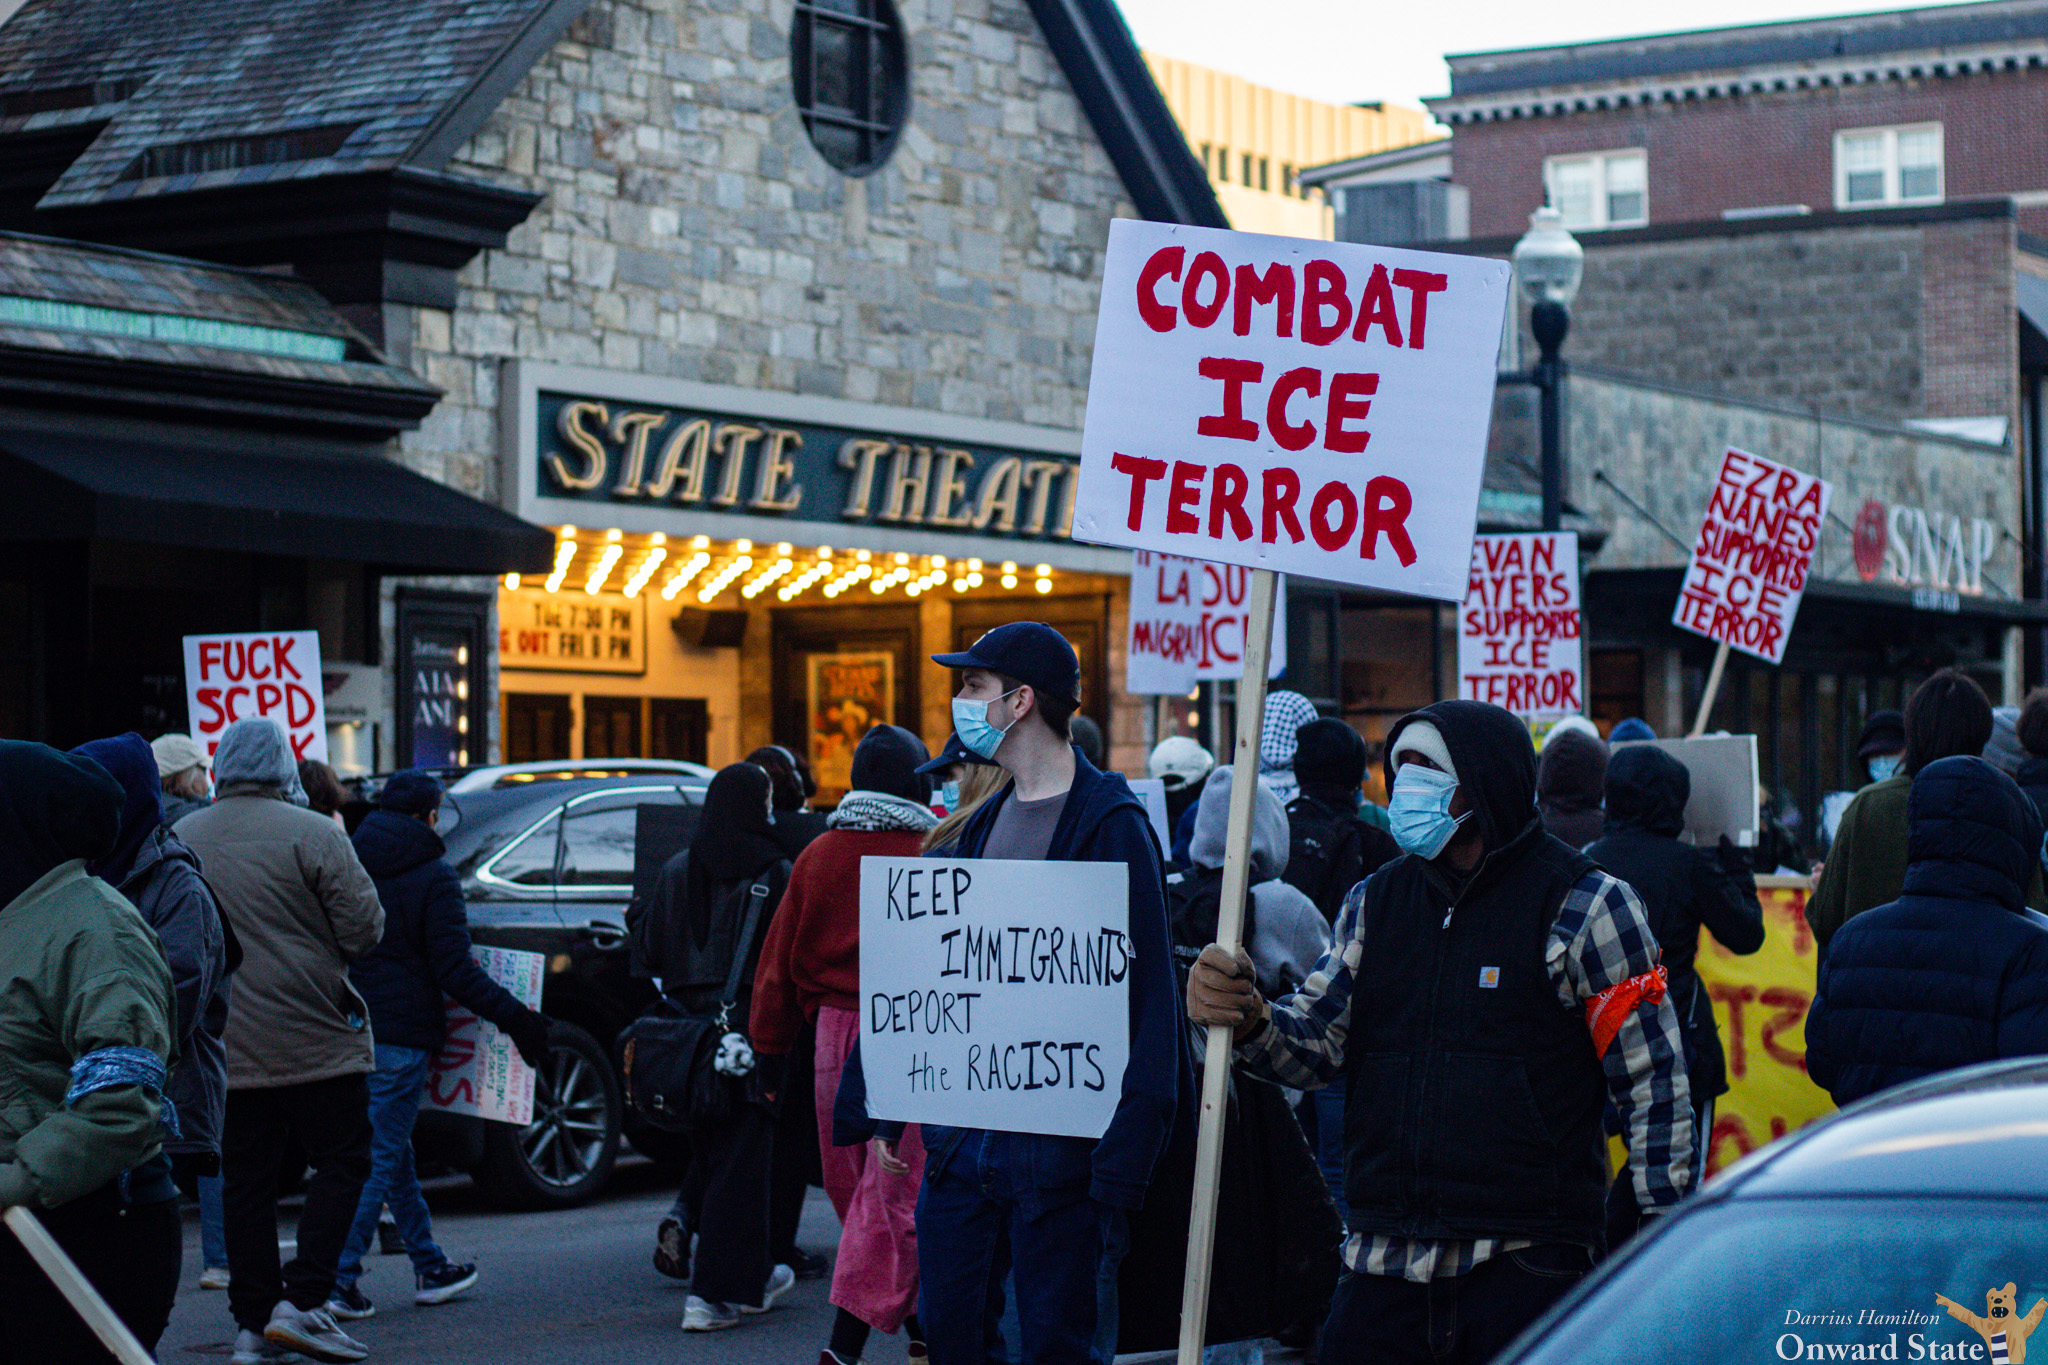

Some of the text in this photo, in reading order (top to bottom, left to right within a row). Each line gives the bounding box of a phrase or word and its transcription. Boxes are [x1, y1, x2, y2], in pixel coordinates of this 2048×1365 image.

[1136, 245, 1448, 350] COMBAT
[1197, 356, 1380, 453] ICE
[546, 400, 802, 511] STATE
[1719, 451, 1822, 515] EZRA
[1111, 451, 1418, 568] TERROR
[1708, 485, 1819, 552] NANES
[1697, 519, 1808, 591] SUPPORTS
[1887, 503, 1994, 597] SNAP
[1462, 573, 1570, 608] MYERS
[1690, 561, 1788, 621] ICE
[518, 630, 549, 655] OUT
[560, 632, 584, 658] FRI
[1464, 607, 1580, 640] SUPPORTS
[1681, 590, 1782, 658] TERROR
[198, 636, 302, 682] FUCK
[1484, 641, 1550, 669] ICE
[196, 682, 316, 734] SCPD
[1464, 670, 1581, 711] TERROR
[887, 867, 971, 921] KEEP
[941, 924, 1127, 987] IMMIGRANTS
[871, 989, 981, 1035] DEPORT
[907, 1040, 1105, 1093] the RACISTS
